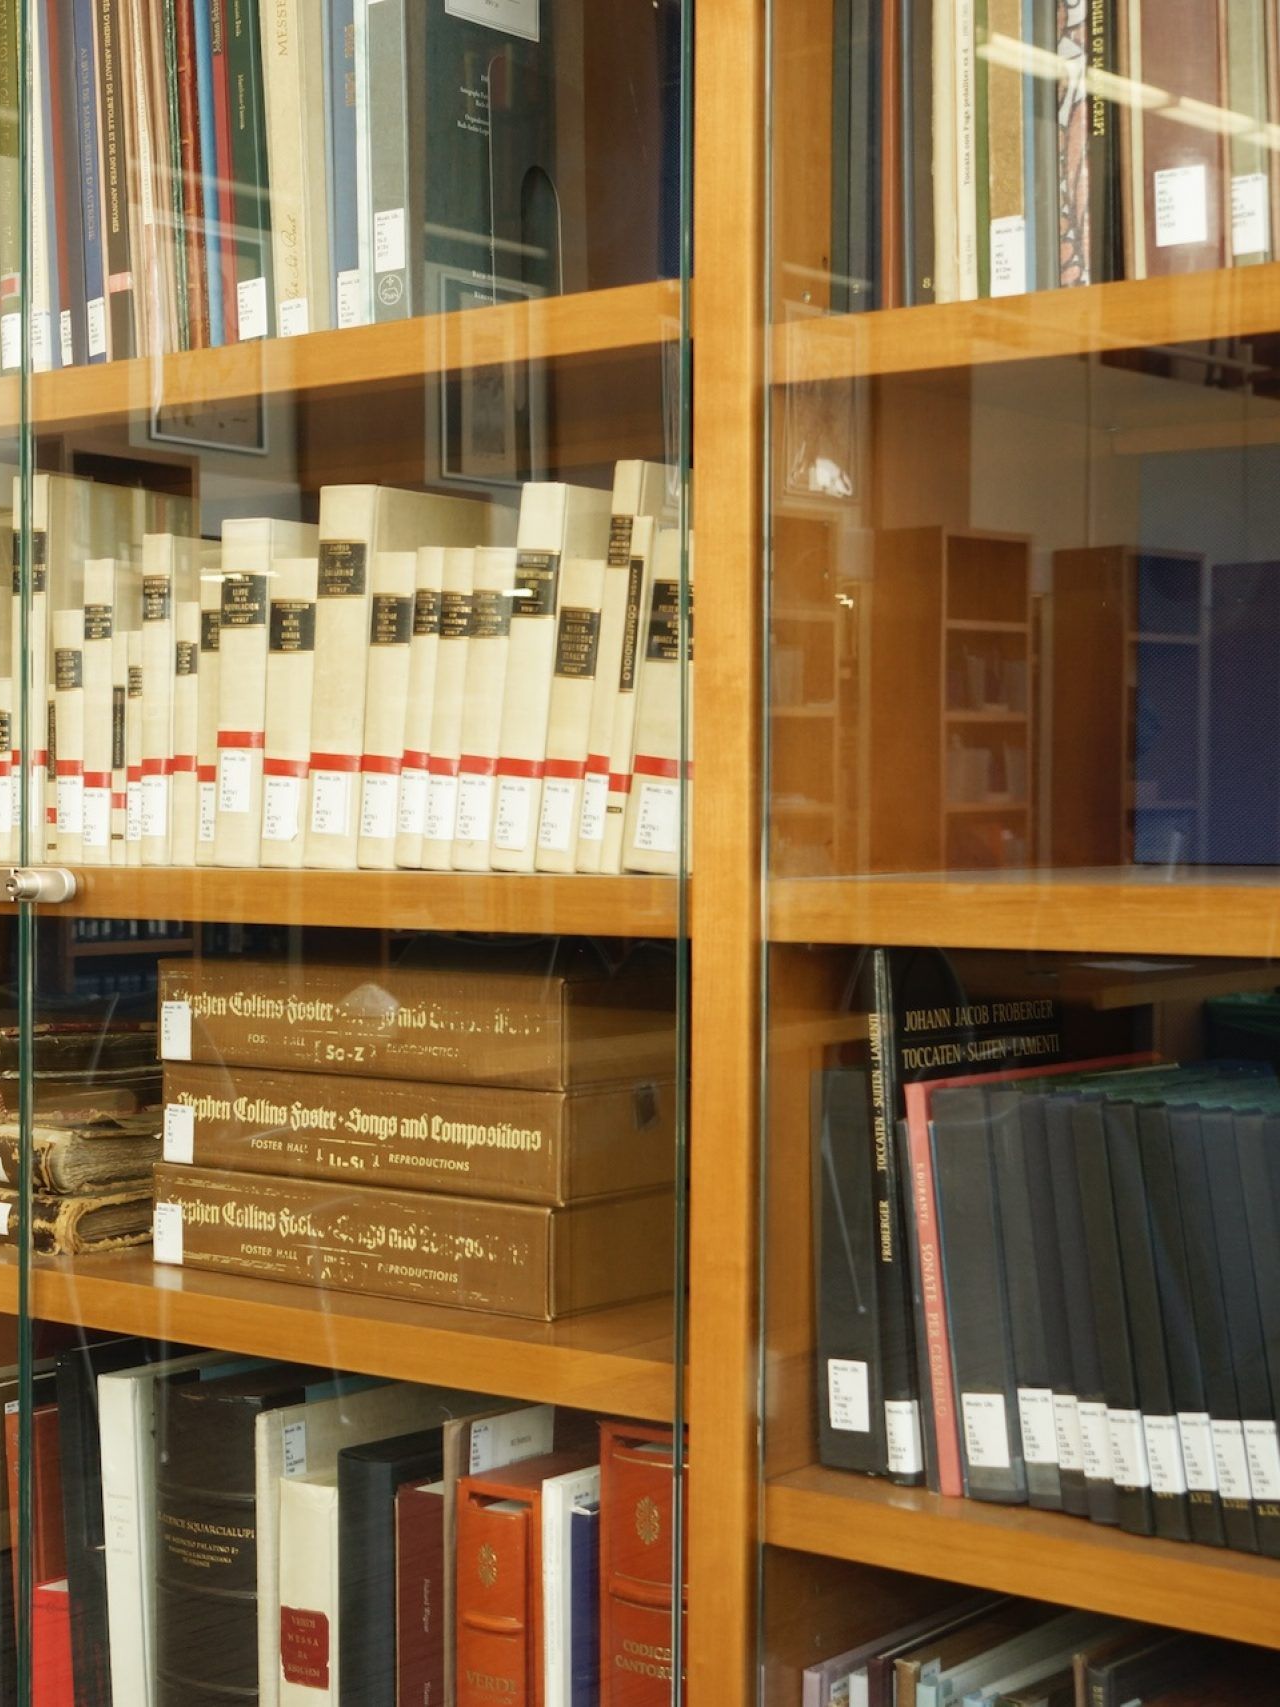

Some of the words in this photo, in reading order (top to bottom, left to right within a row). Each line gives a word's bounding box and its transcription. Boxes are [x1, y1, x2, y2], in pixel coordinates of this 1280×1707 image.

[1092, 39, 1104, 54] OF
[110, 187, 120, 233] ANONYMES
[622, 604, 638, 681] COMPENDIOLO
[228, 992, 284, 1020] Collins
[286, 994, 333, 1025] Foster
[903, 1008, 951, 1032] JOHANN
[954, 1004, 990, 1028] JACOB
[992, 999, 1055, 1024] FROBERGER
[868, 1012, 882, 1061] LAMENTI
[901, 1042, 962, 1071] TOCCATEN
[967, 1038, 1007, 1064] SUITEN
[1012, 1033, 1060, 1058] LAMENTI
[872, 1069, 885, 1108] SUITEN
[232, 1096, 288, 1125] Collins
[290, 1101, 337, 1132] Foster
[344, 1108, 398, 1141] Songs
[401, 1113, 429, 1141] and
[431, 1114, 541, 1151] Compositions
[251, 1139, 283, 1151] FOSTER
[875, 1116, 888, 1172] TOCCATEN
[388, 1153, 470, 1172] REPRODUCTIONS
[222, 1201, 277, 1233] Collins
[880, 1200, 892, 1262] FROBERGER
[377, 1261, 459, 1284] RPRODUCTIONS
[921, 1242, 939, 1303] SONATE
[926, 1312, 942, 1337] PER
[187, 1521, 256, 1540] SQUARCIALUPI
[623, 1639, 672, 1662] CODICE
